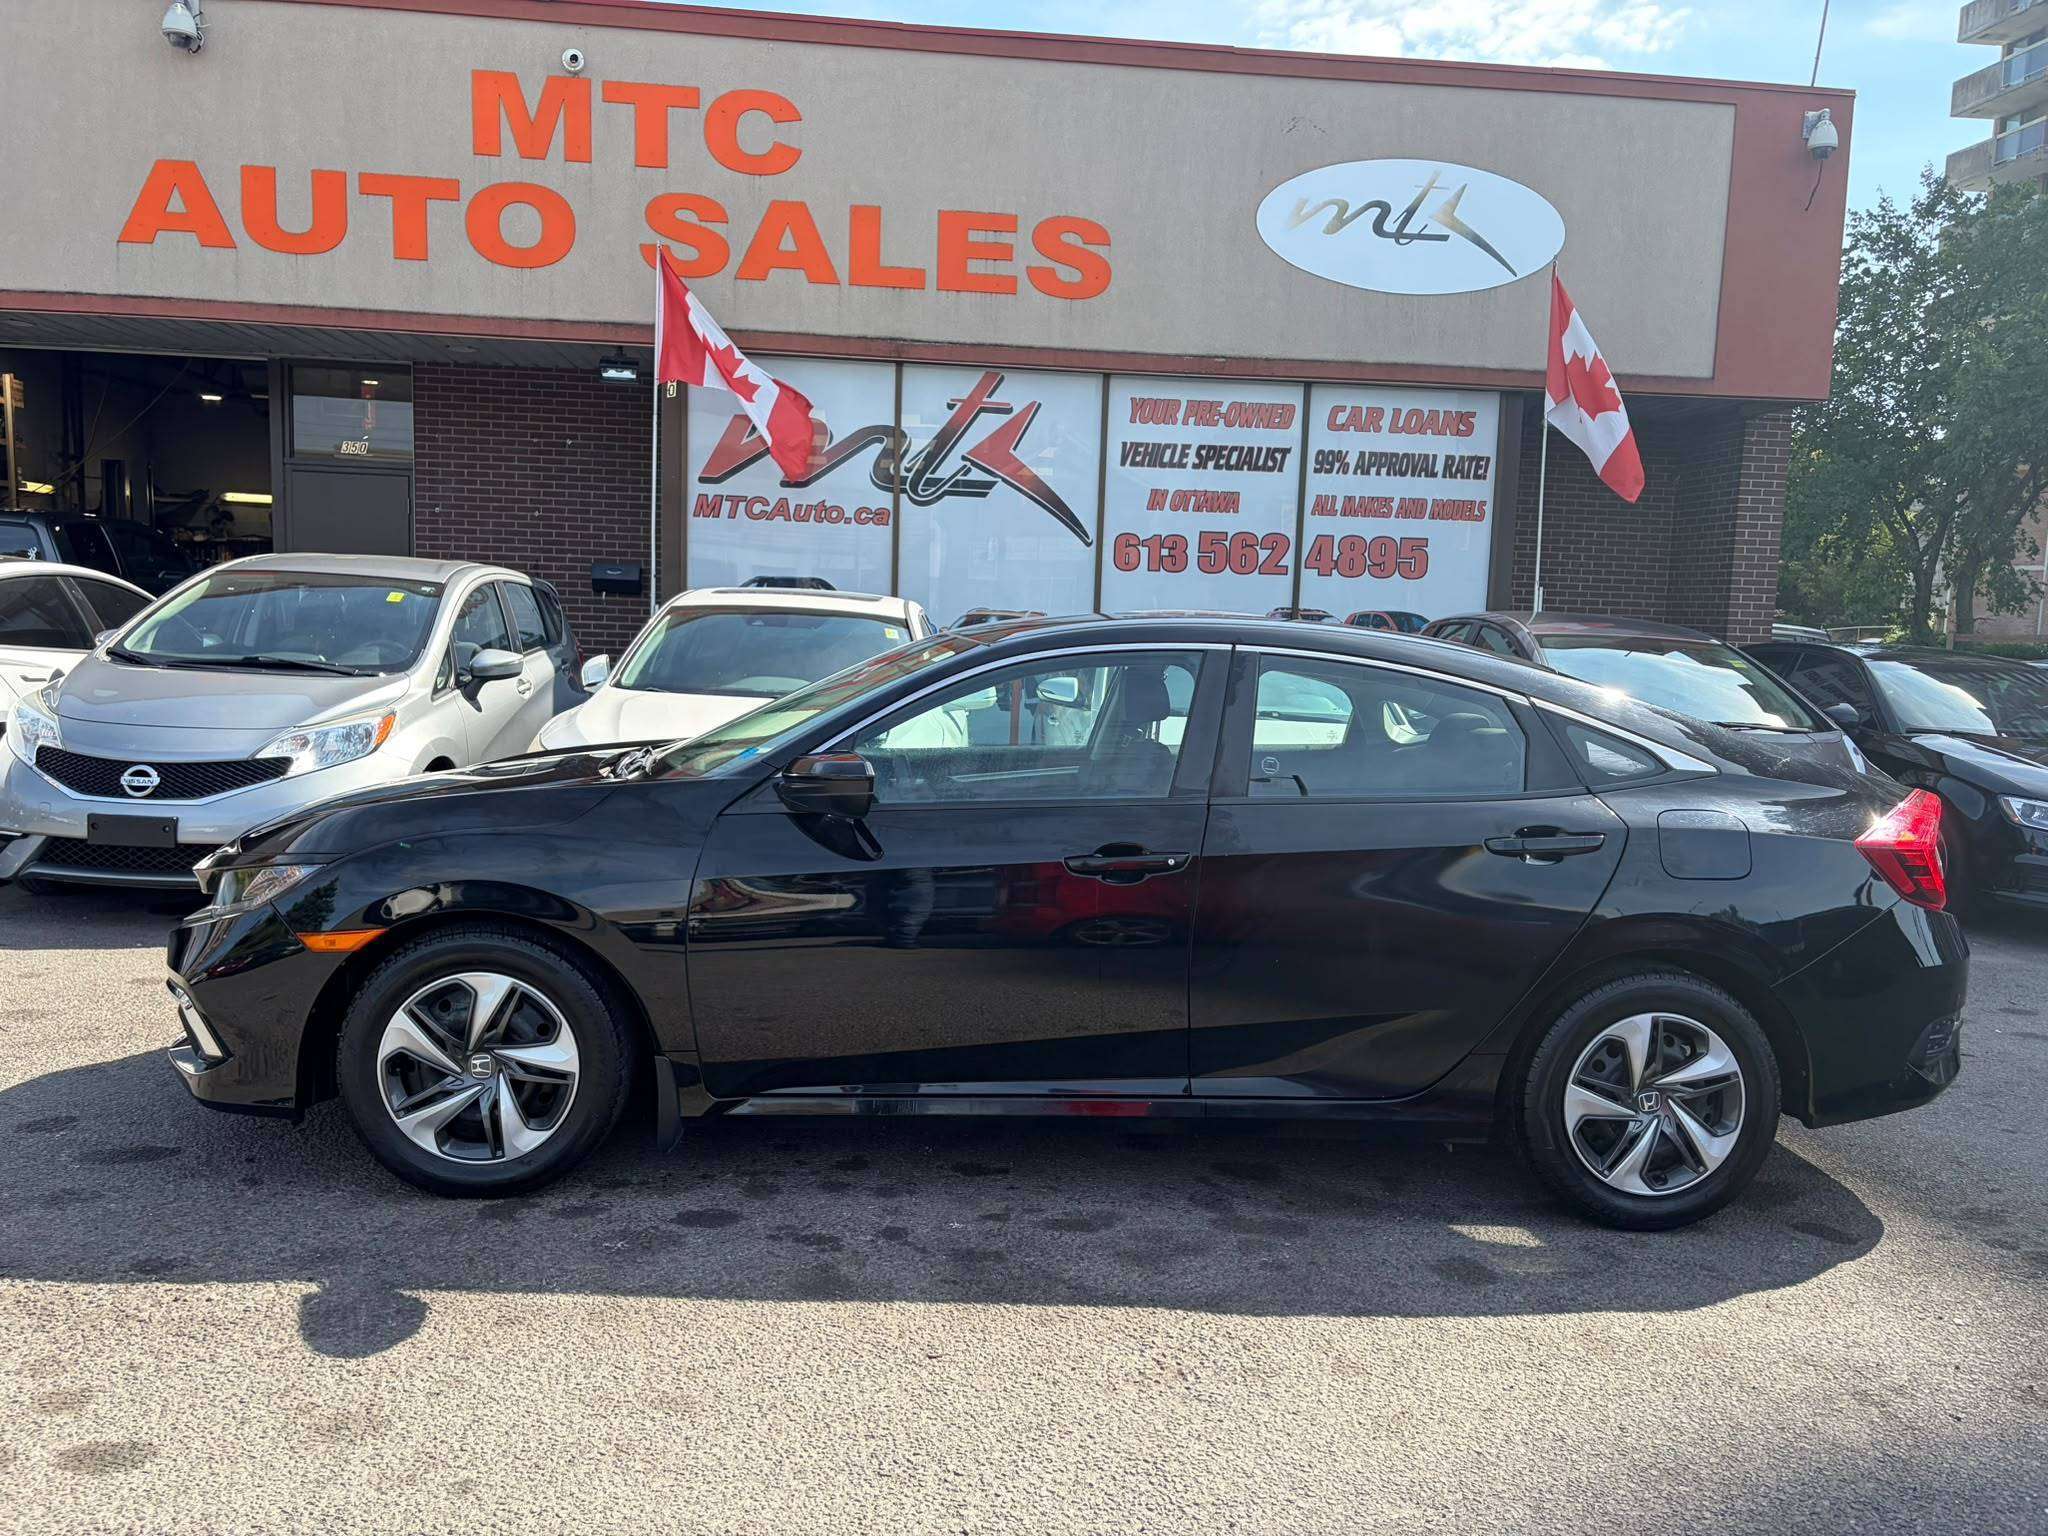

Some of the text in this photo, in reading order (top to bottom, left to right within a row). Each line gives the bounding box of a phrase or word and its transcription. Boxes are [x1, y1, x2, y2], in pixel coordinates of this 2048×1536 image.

[471, 69, 803, 176] MTC
[117, 159, 1112, 300] AUTO SALES
[1129, 397, 1297, 430] YOUR PRE-OWNED
[1327, 405, 1477, 437] CAR LOANS
[341, 440, 368, 454] 350
[1119, 441, 1292, 473] VEHICLE SPECIALIST
[1313, 449, 1491, 480] 99% APPROVAL RATE!
[693, 494, 890, 526] MTCAuto.ca
[1146, 488, 1241, 514] IN OTTAWA
[1310, 494, 1487, 522] ALL MAKES AND MODELS
[1113, 531, 1429, 579] 613 562 4895
[122, 777, 155, 785] NISSAN
